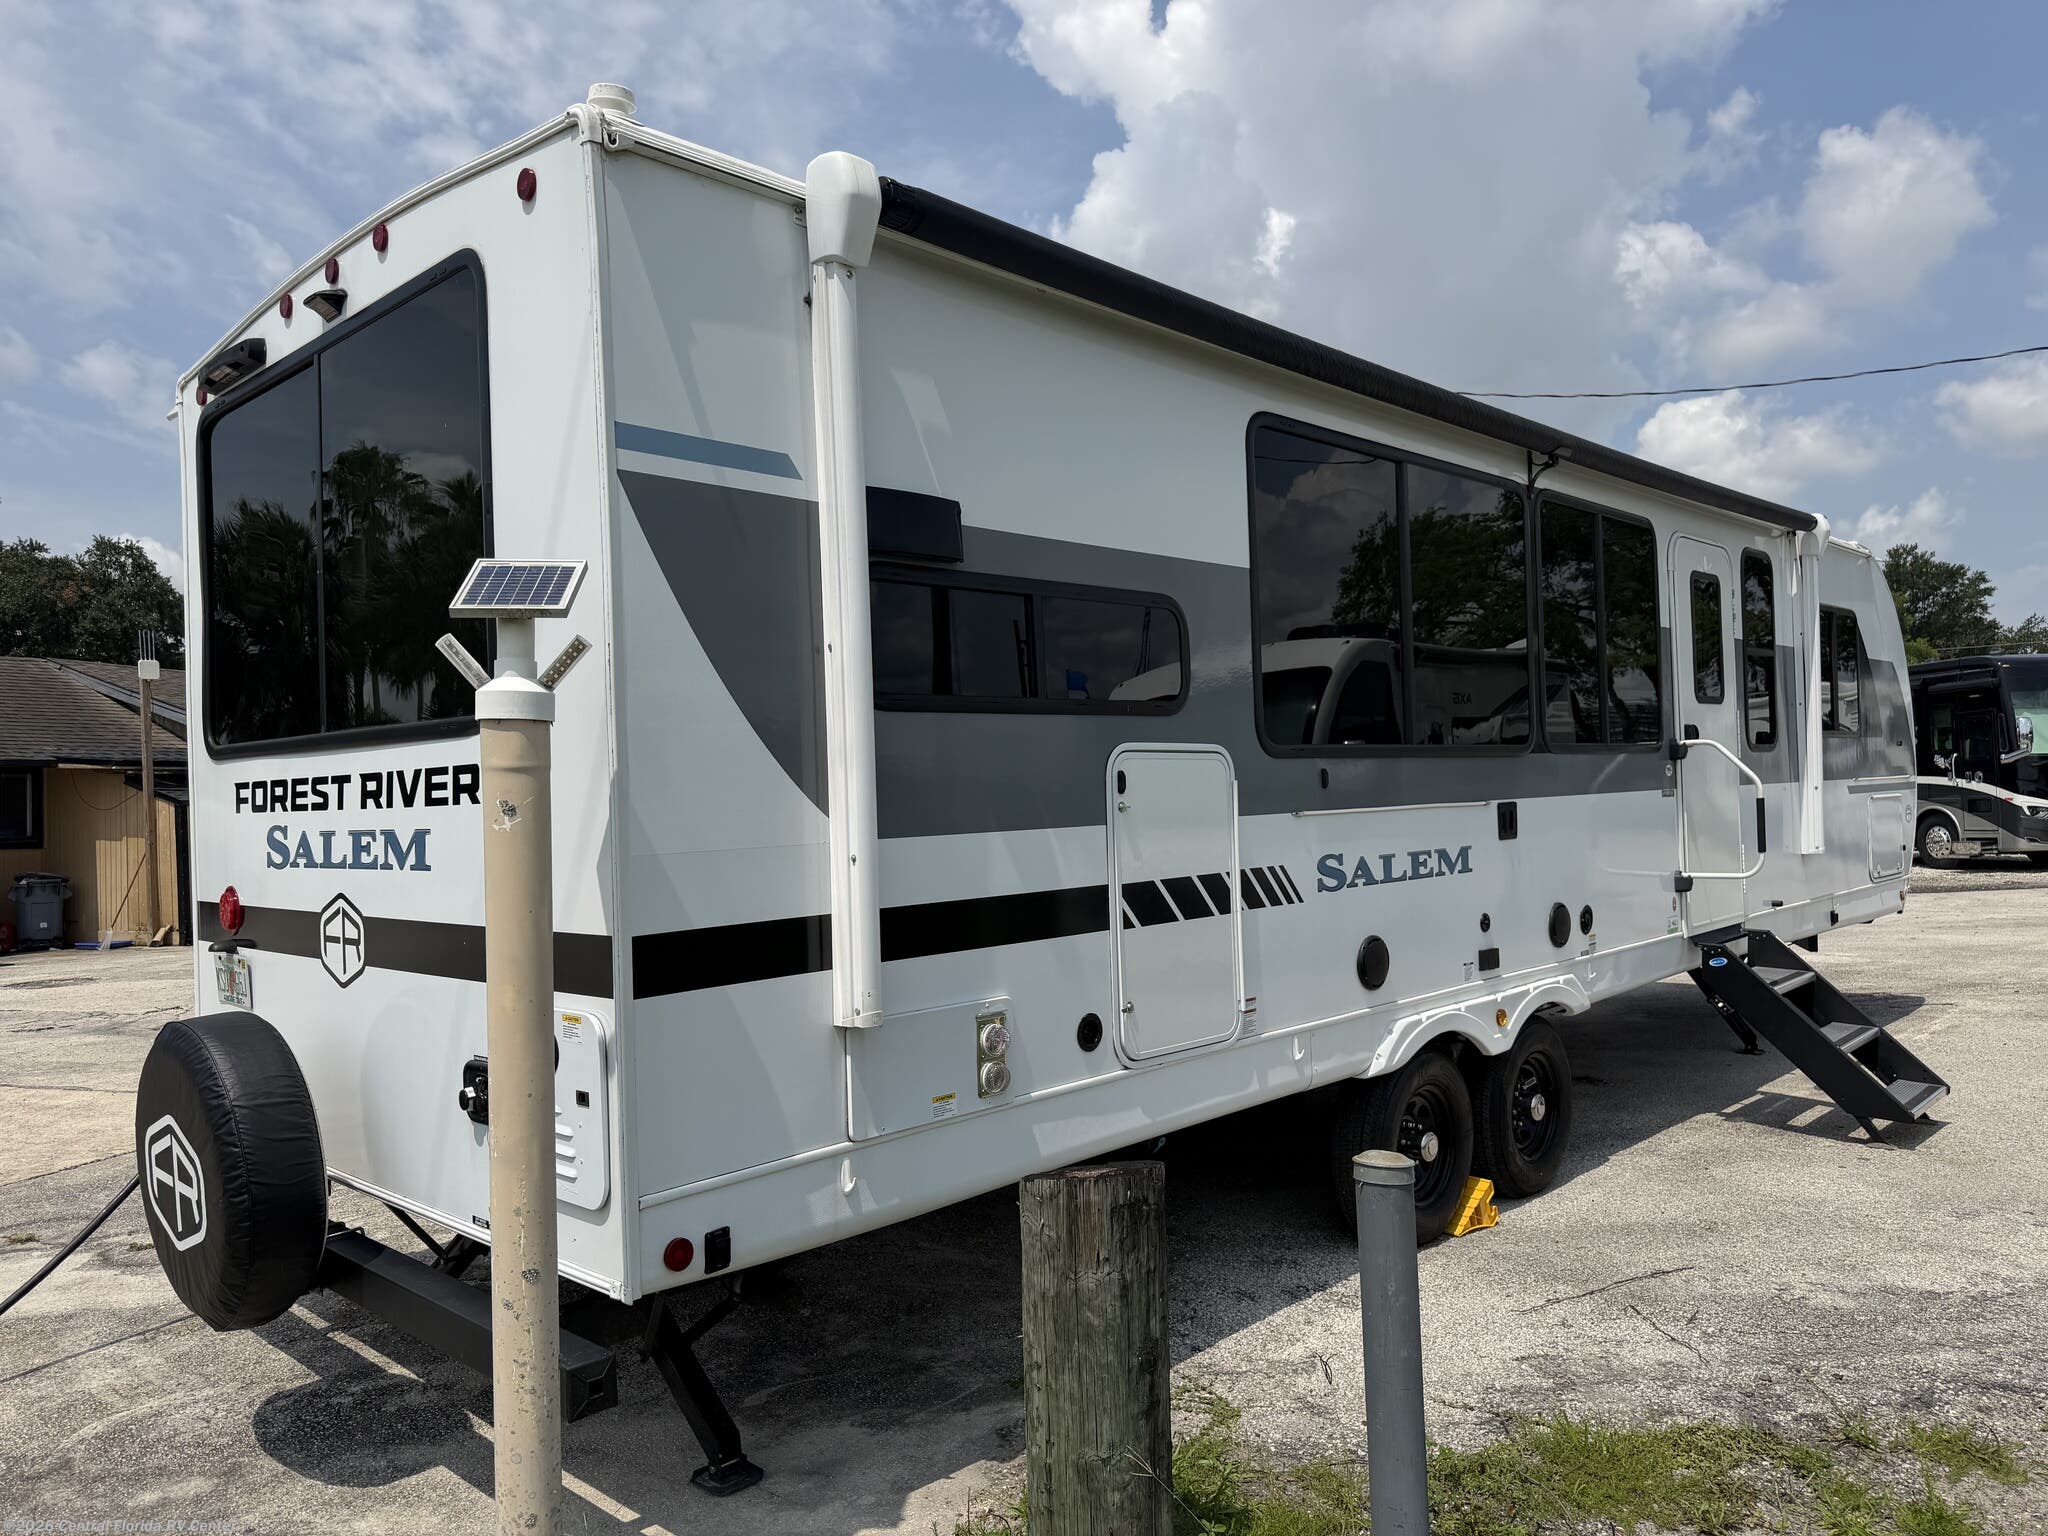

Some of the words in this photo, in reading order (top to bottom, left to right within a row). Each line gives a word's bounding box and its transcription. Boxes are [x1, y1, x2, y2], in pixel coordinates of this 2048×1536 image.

[234, 774, 351, 814] FOREST
[359, 763, 481, 810] RIVER
[266, 824, 432, 872] SALEM
[1316, 845, 1473, 893] SALEM
